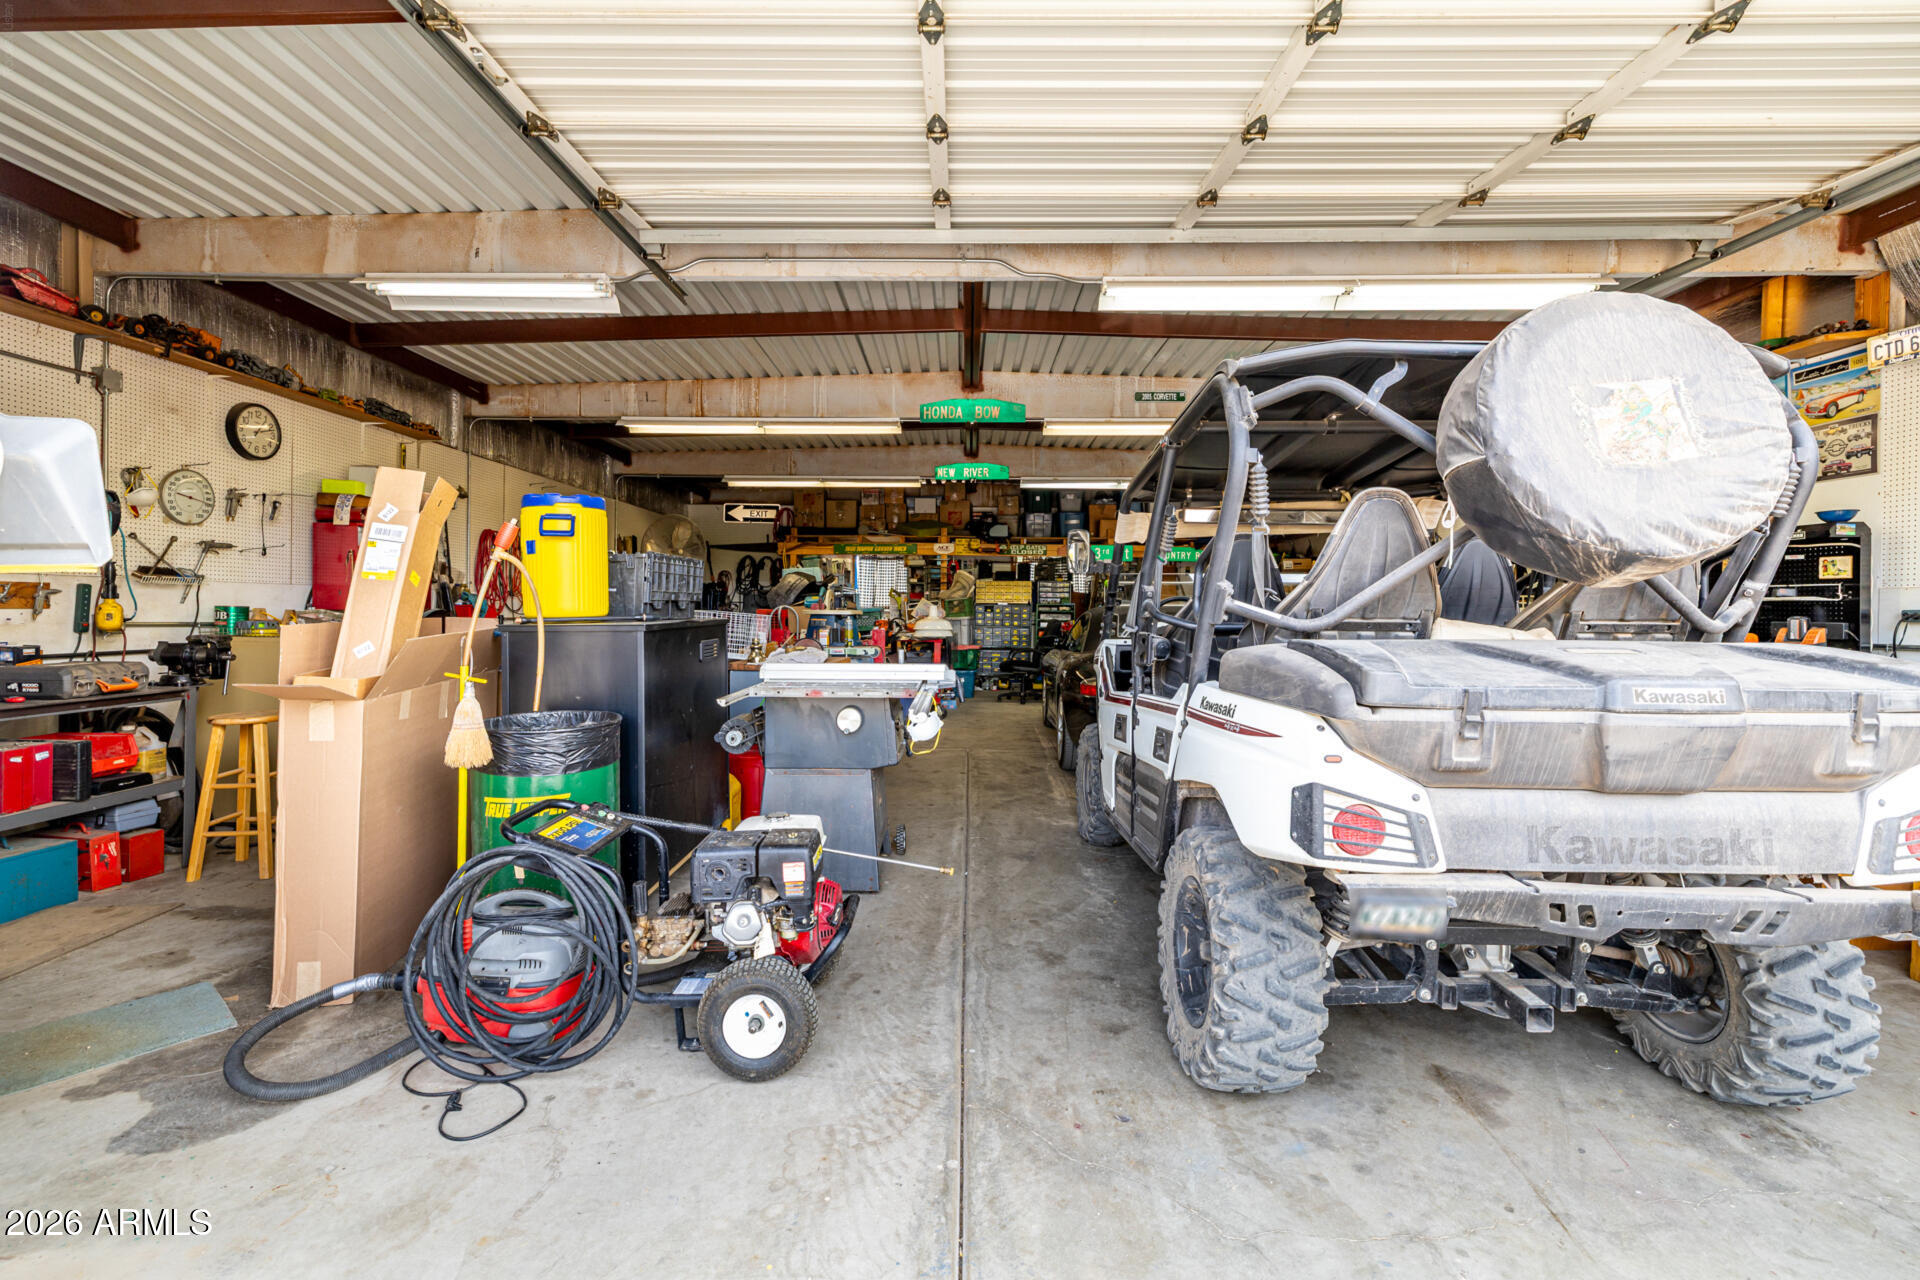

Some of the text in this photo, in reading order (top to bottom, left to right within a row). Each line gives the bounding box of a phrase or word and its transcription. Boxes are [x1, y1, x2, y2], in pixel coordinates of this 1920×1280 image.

[1874, 339, 1904, 360] CTD
[1153, 393, 1178, 401] CORVETTE
[255, 410, 262, 420] 12
[923, 405, 963, 420] HONDA
[975, 405, 1001, 419] BOW
[937, 467, 956, 478] NEW
[963, 467, 989, 478] RIVER
[750, 510, 768, 518] EXIT
[1095, 547, 1110, 560] 3rd
[1634, 689, 1725, 704] Kawasaki
[1200, 696, 1237, 718] Kawasaki
[484, 797, 513, 818] TRUE
[1527, 825, 1776, 866] Kawasaki
